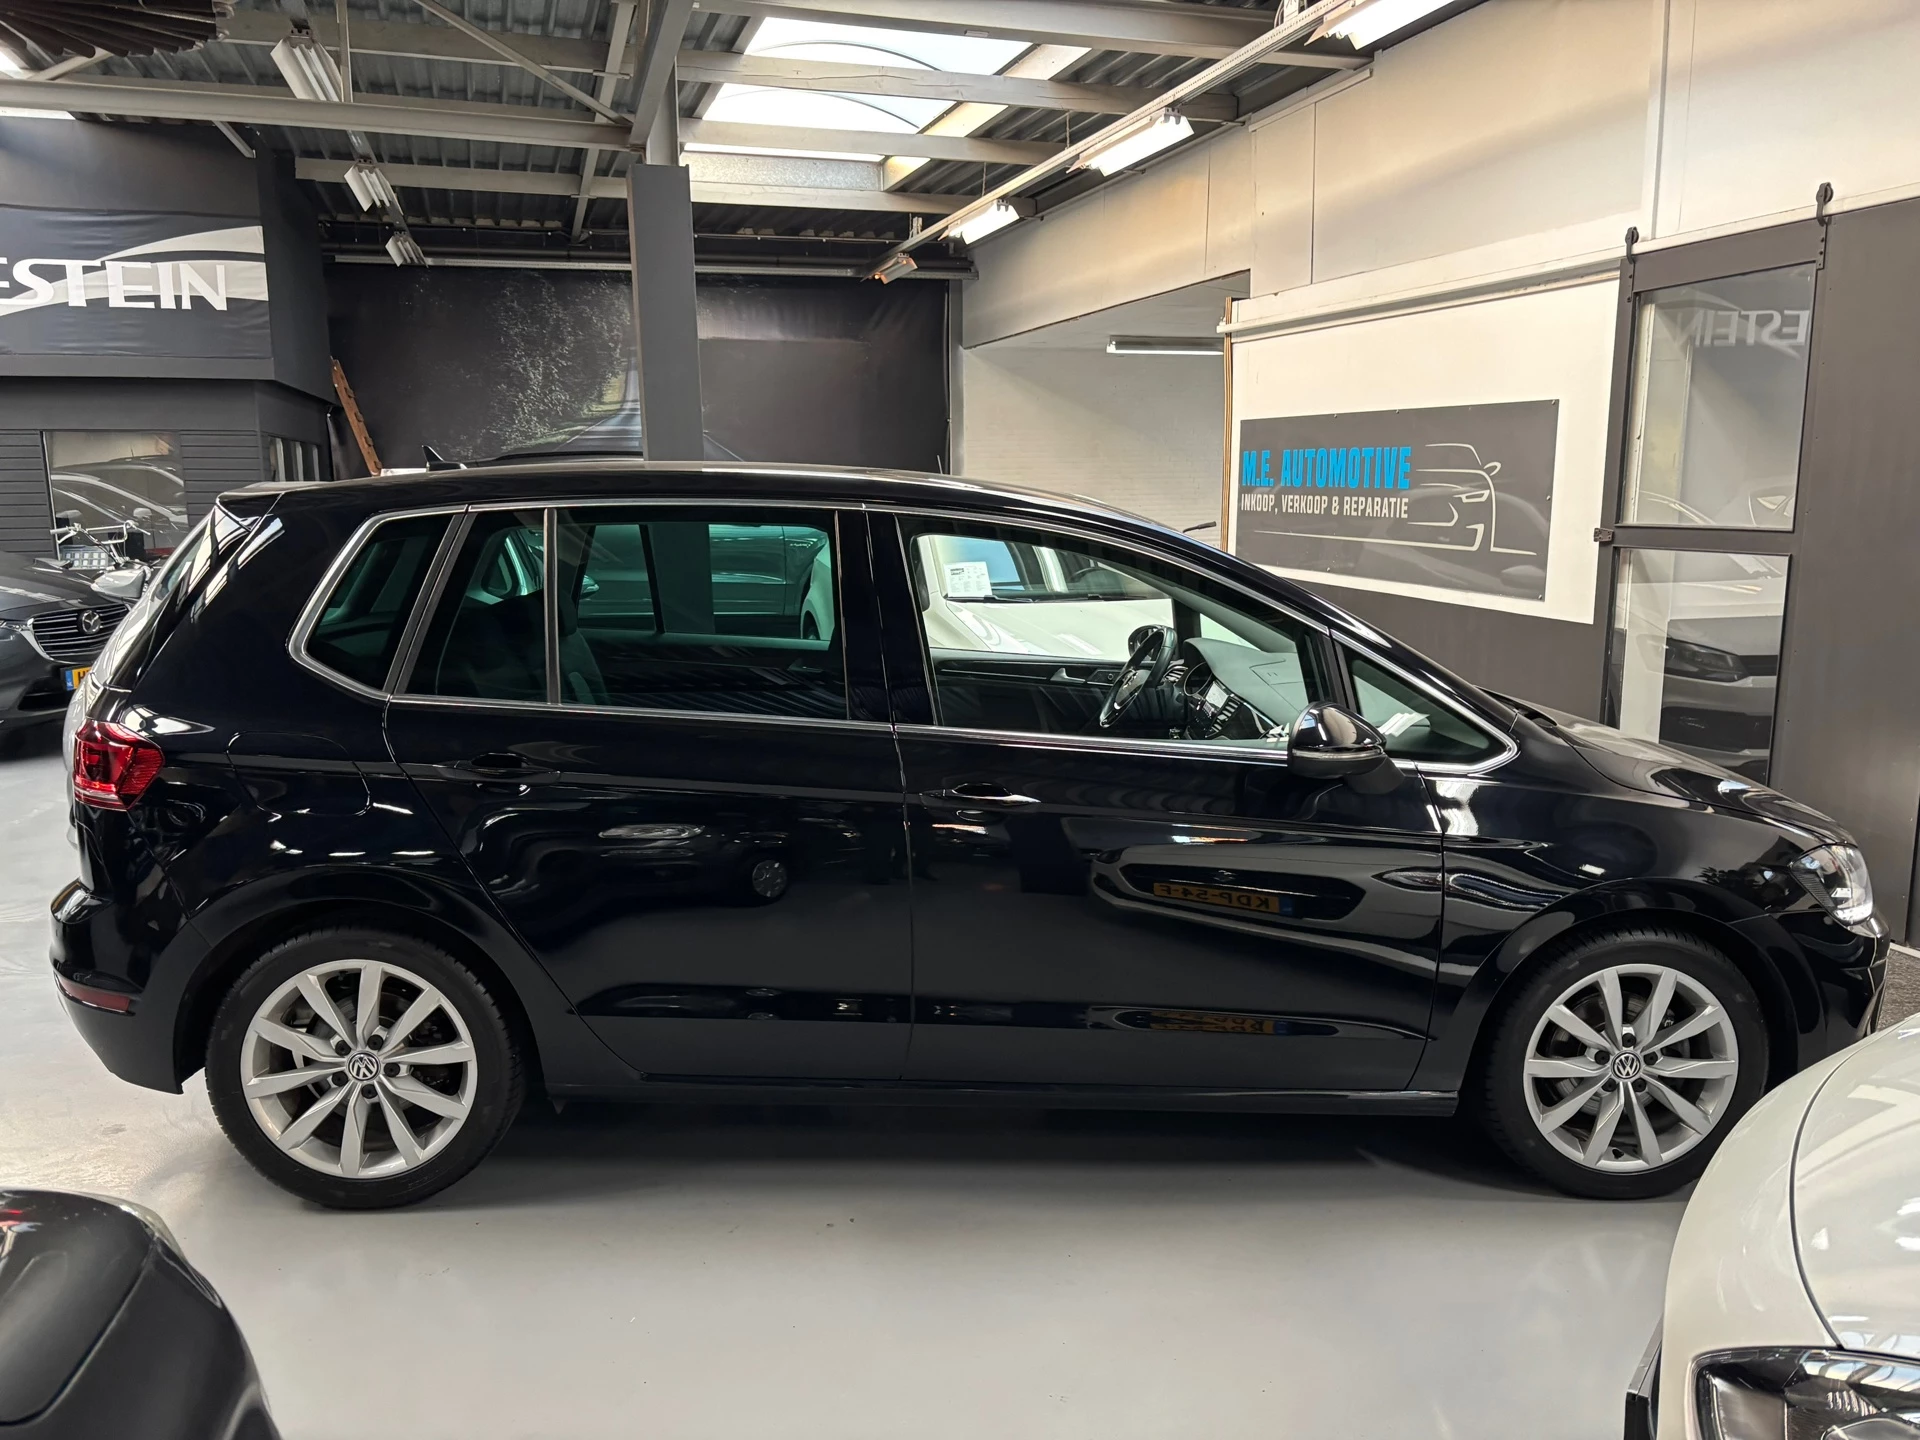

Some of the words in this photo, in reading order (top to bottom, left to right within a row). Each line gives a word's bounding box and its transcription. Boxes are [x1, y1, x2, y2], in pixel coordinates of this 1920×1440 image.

[0, 257, 227, 310] STEIN
[1242, 450, 1275, 487] M.E.
[1280, 446, 1412, 489] AUTOMOTIVE
[1241, 493, 1278, 515] INKOOP,
[1281, 495, 1328, 515] VERKOOP
[1331, 496, 1340, 515] &
[1343, 496, 1409, 519] REPARATIE
